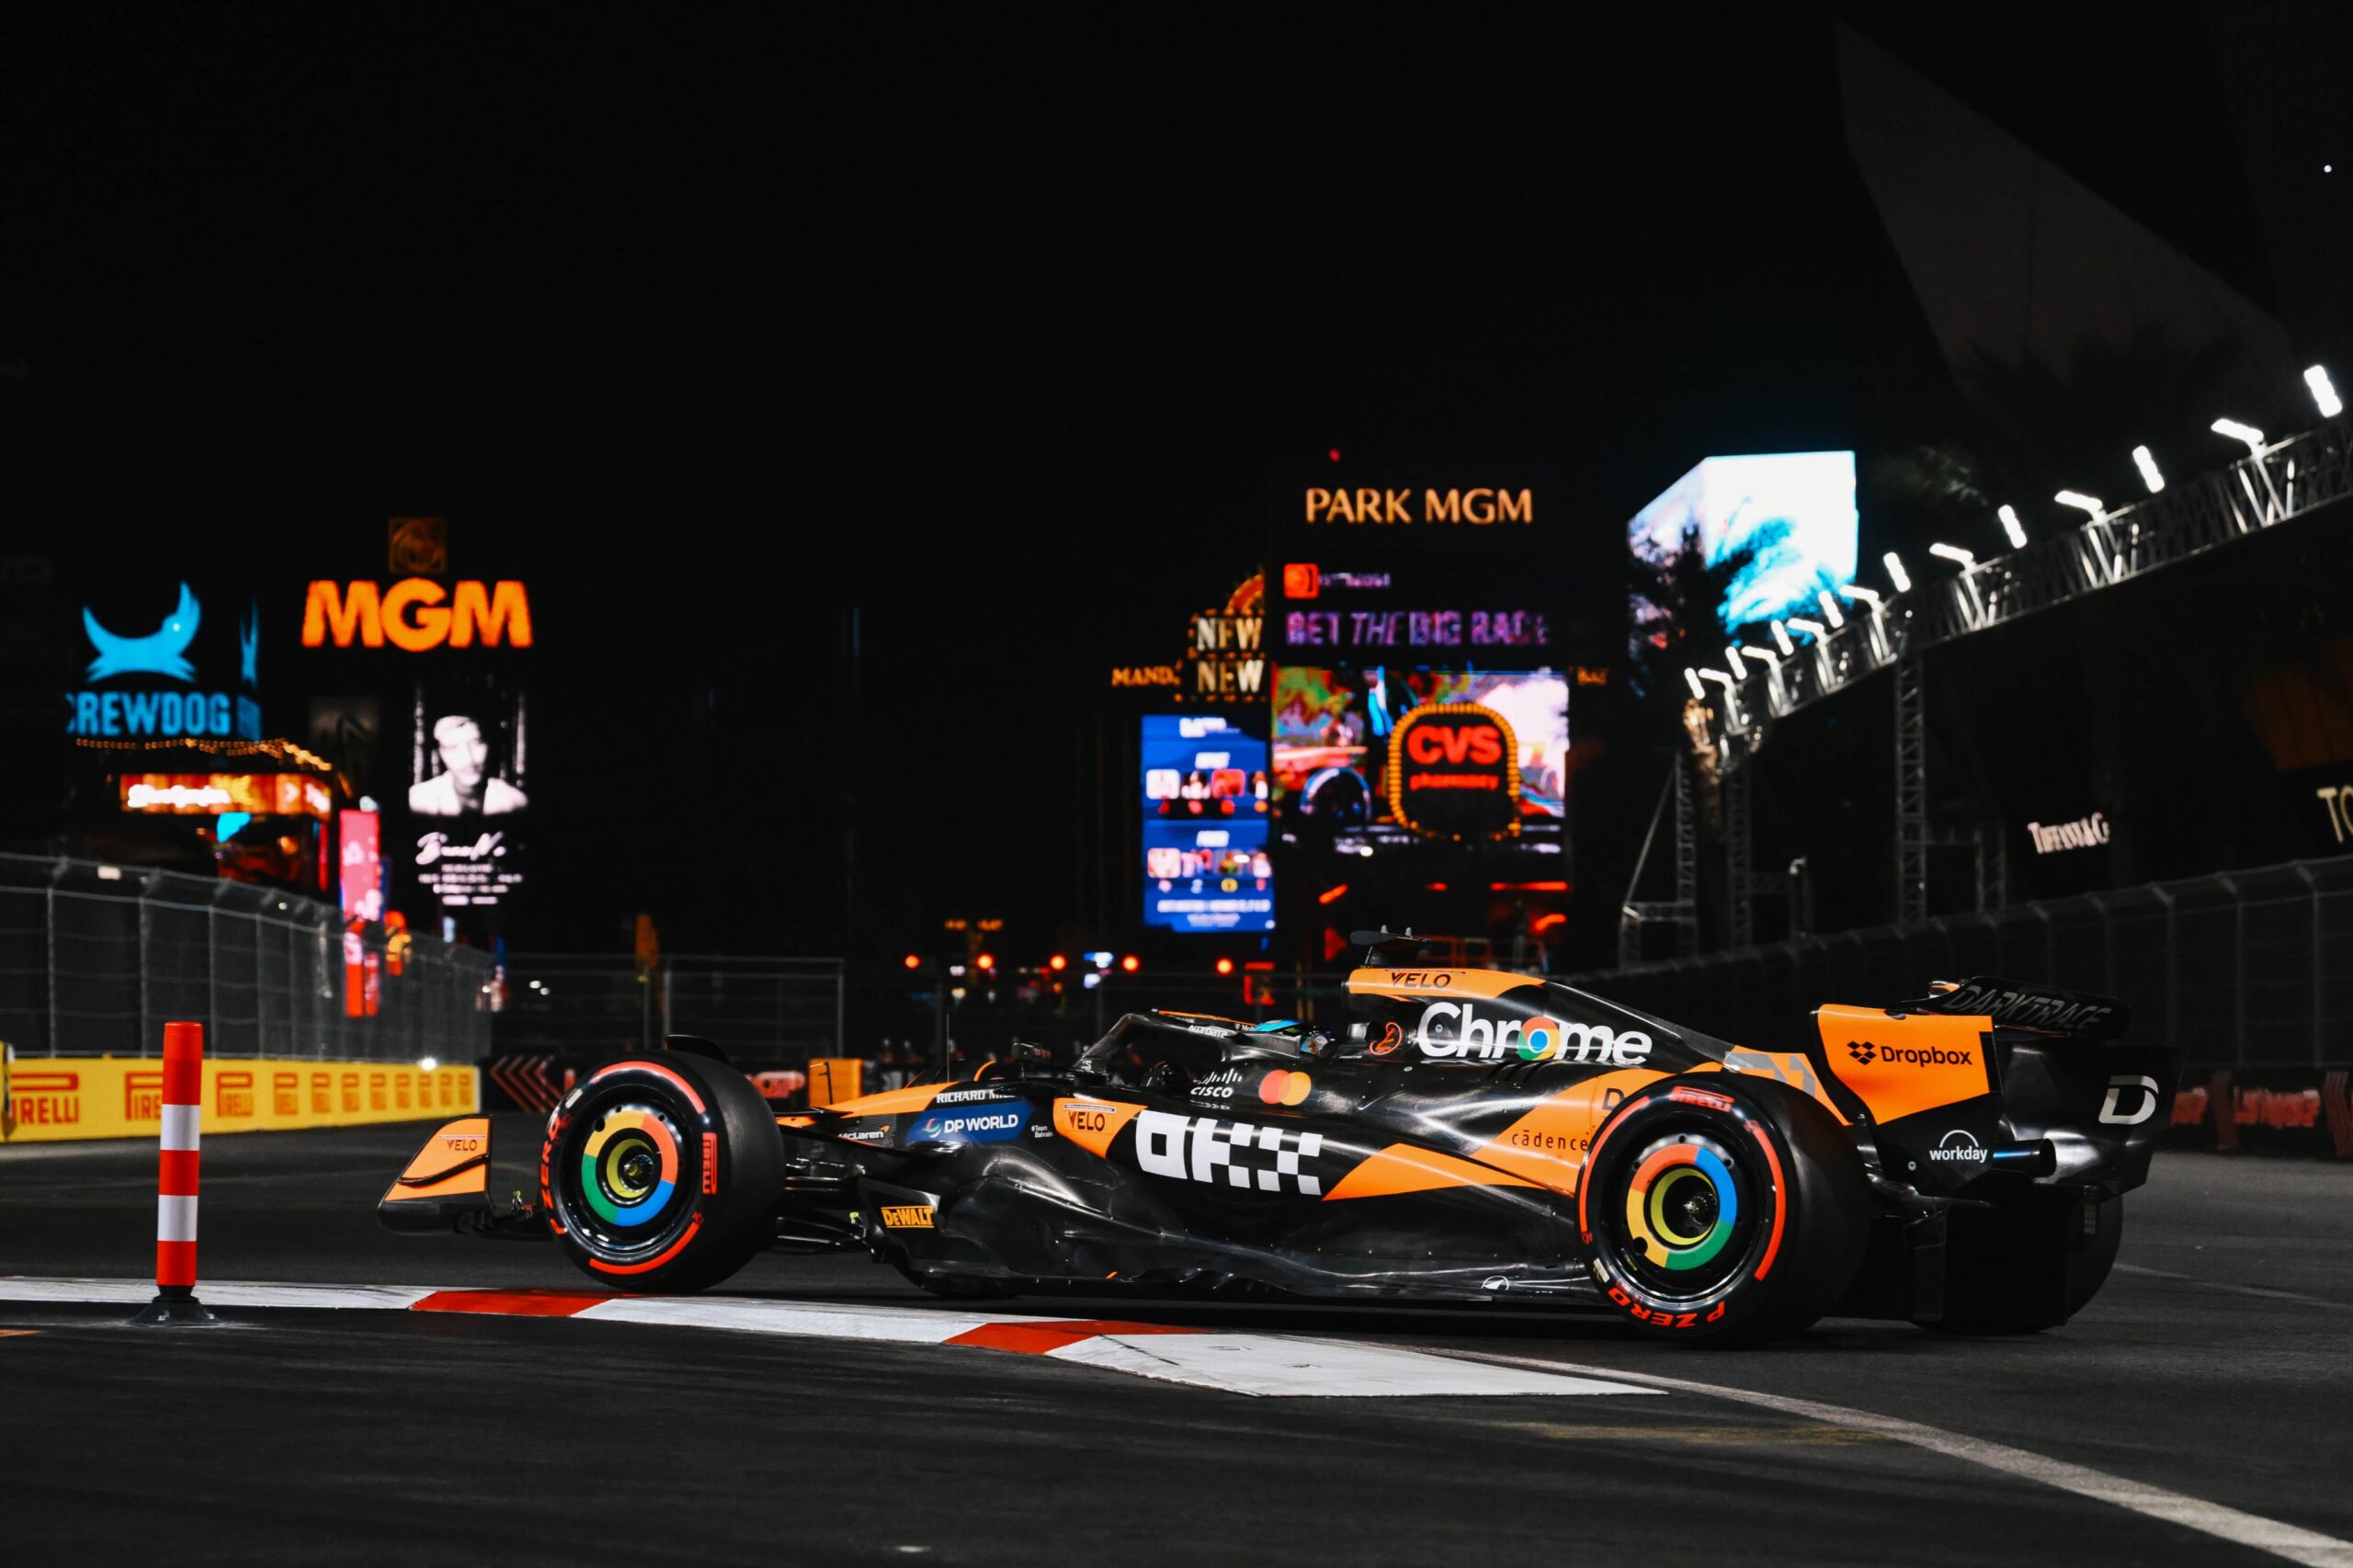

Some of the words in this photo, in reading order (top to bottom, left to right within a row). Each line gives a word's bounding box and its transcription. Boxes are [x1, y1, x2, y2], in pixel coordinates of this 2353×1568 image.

[1305, 487, 1413, 524] PARK
[1425, 487, 1534, 525] MGM
[301, 576, 534, 653] MGM
[1287, 610, 1341, 645] BET
[1350, 610, 1406, 645] THE
[1409, 610, 1463, 645] BIG
[1197, 616, 1263, 651] NEW
[1197, 658, 1265, 693] NEW
[1407, 724, 1503, 765] CVS
[1391, 971, 1451, 988] VELO
[1940, 984, 2112, 1031] DARKTRACE
[1417, 1001, 1654, 1065] Chrome
[1881, 1046, 1972, 1068] Dropbox
[936, 1090, 986, 1104] RICHARD
[1190, 1086, 1233, 1098] CISCO
[2098, 1075, 2160, 1126] D
[944, 1119, 965, 1133] DP
[966, 1114, 1018, 1131] WORLD
[1068, 1110, 1106, 1131] VELO
[447, 1139, 478, 1152] VELO
[1136, 1109, 1324, 1196] OKX
[1929, 1145, 1988, 1165] workday
[1608, 1287, 1699, 1329] ZERO
[1706, 1300, 1726, 1323] P
